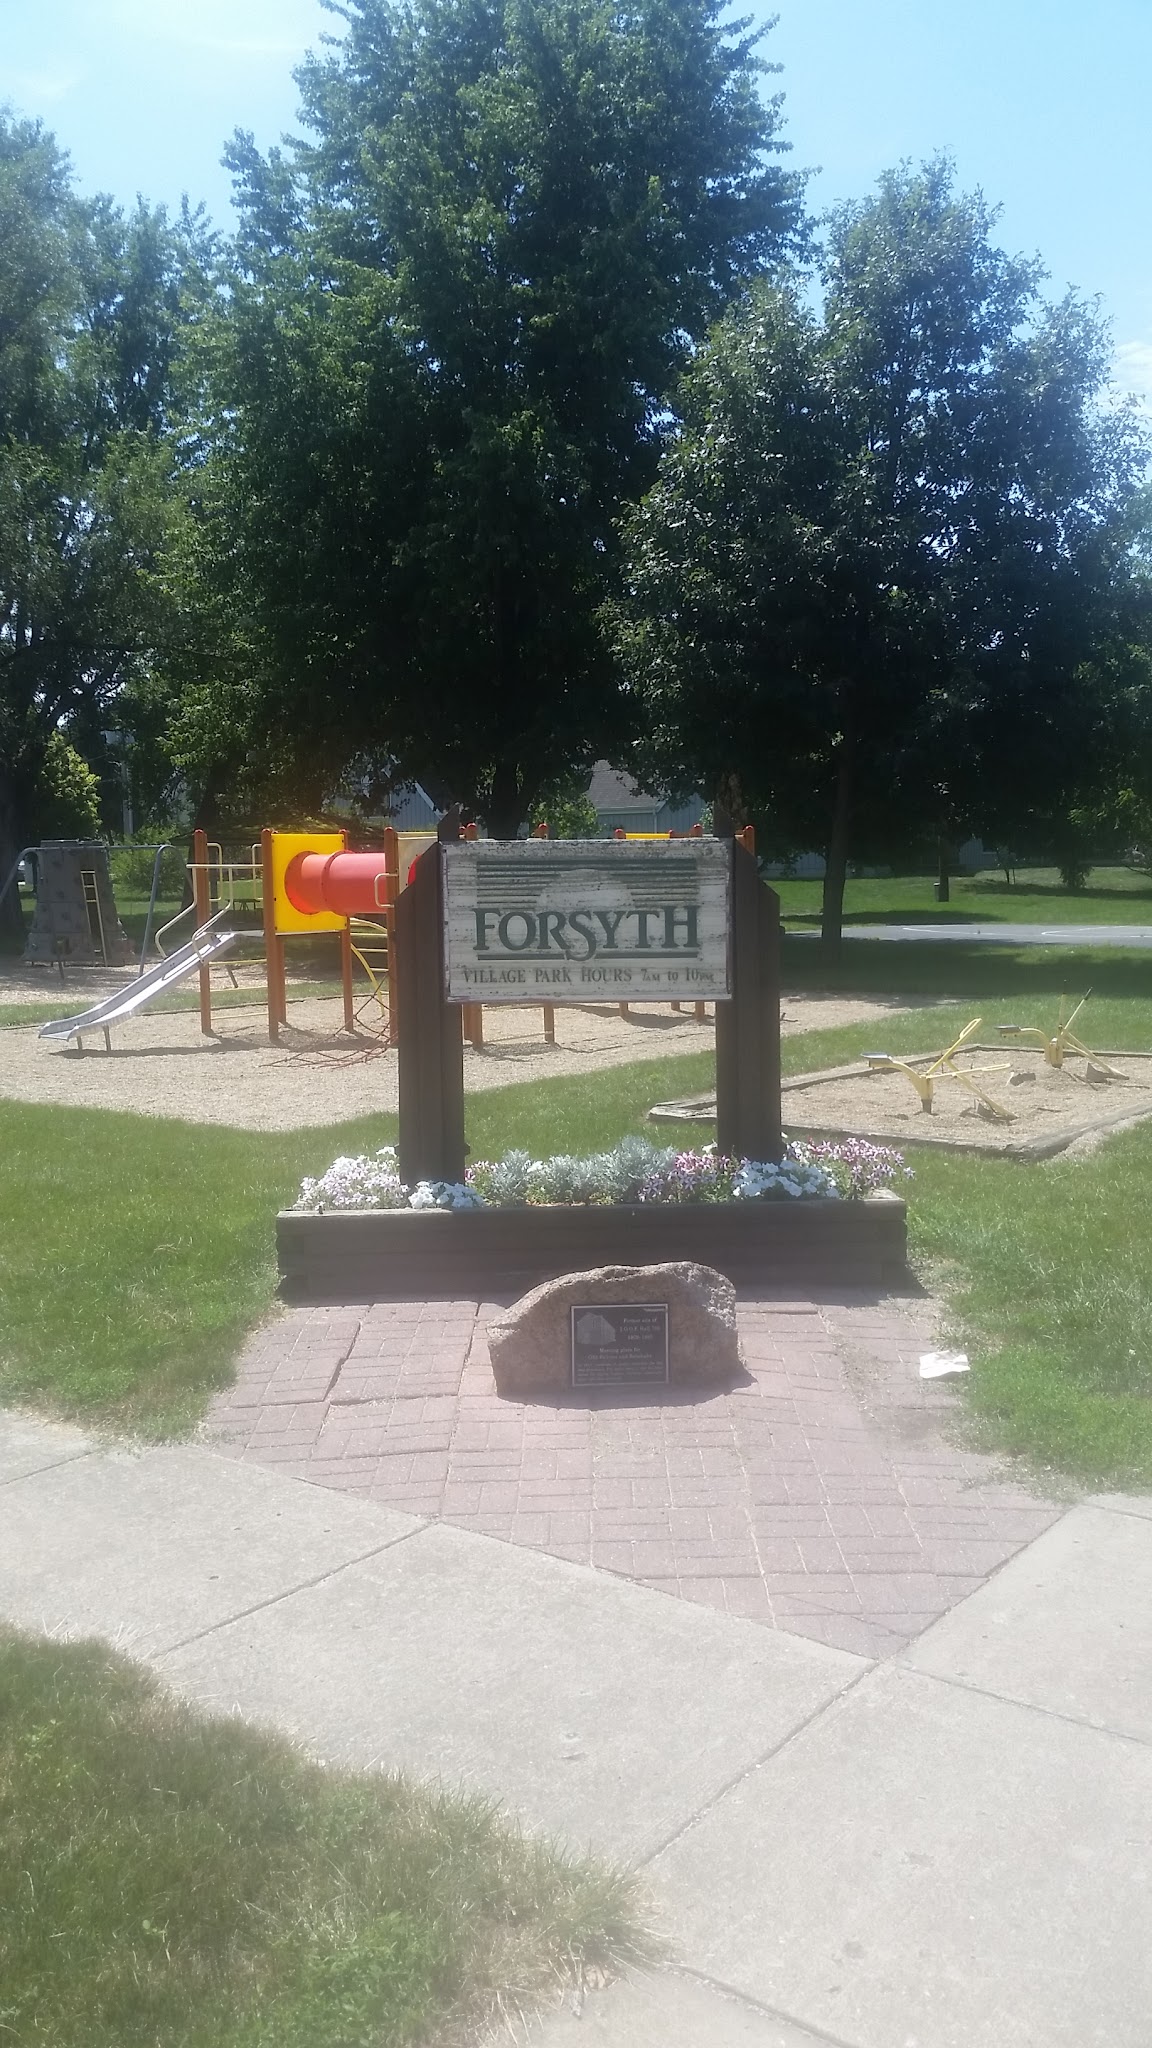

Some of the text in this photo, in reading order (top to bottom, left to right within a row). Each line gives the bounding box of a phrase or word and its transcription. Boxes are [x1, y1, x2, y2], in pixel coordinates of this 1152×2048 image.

[472, 905, 701, 962] FORSYTH
[463, 968, 526, 983] VILLAGE
[535, 967, 572, 983] PARK
[580, 966, 632, 982] HOURS
[667, 970, 679, 981] to
